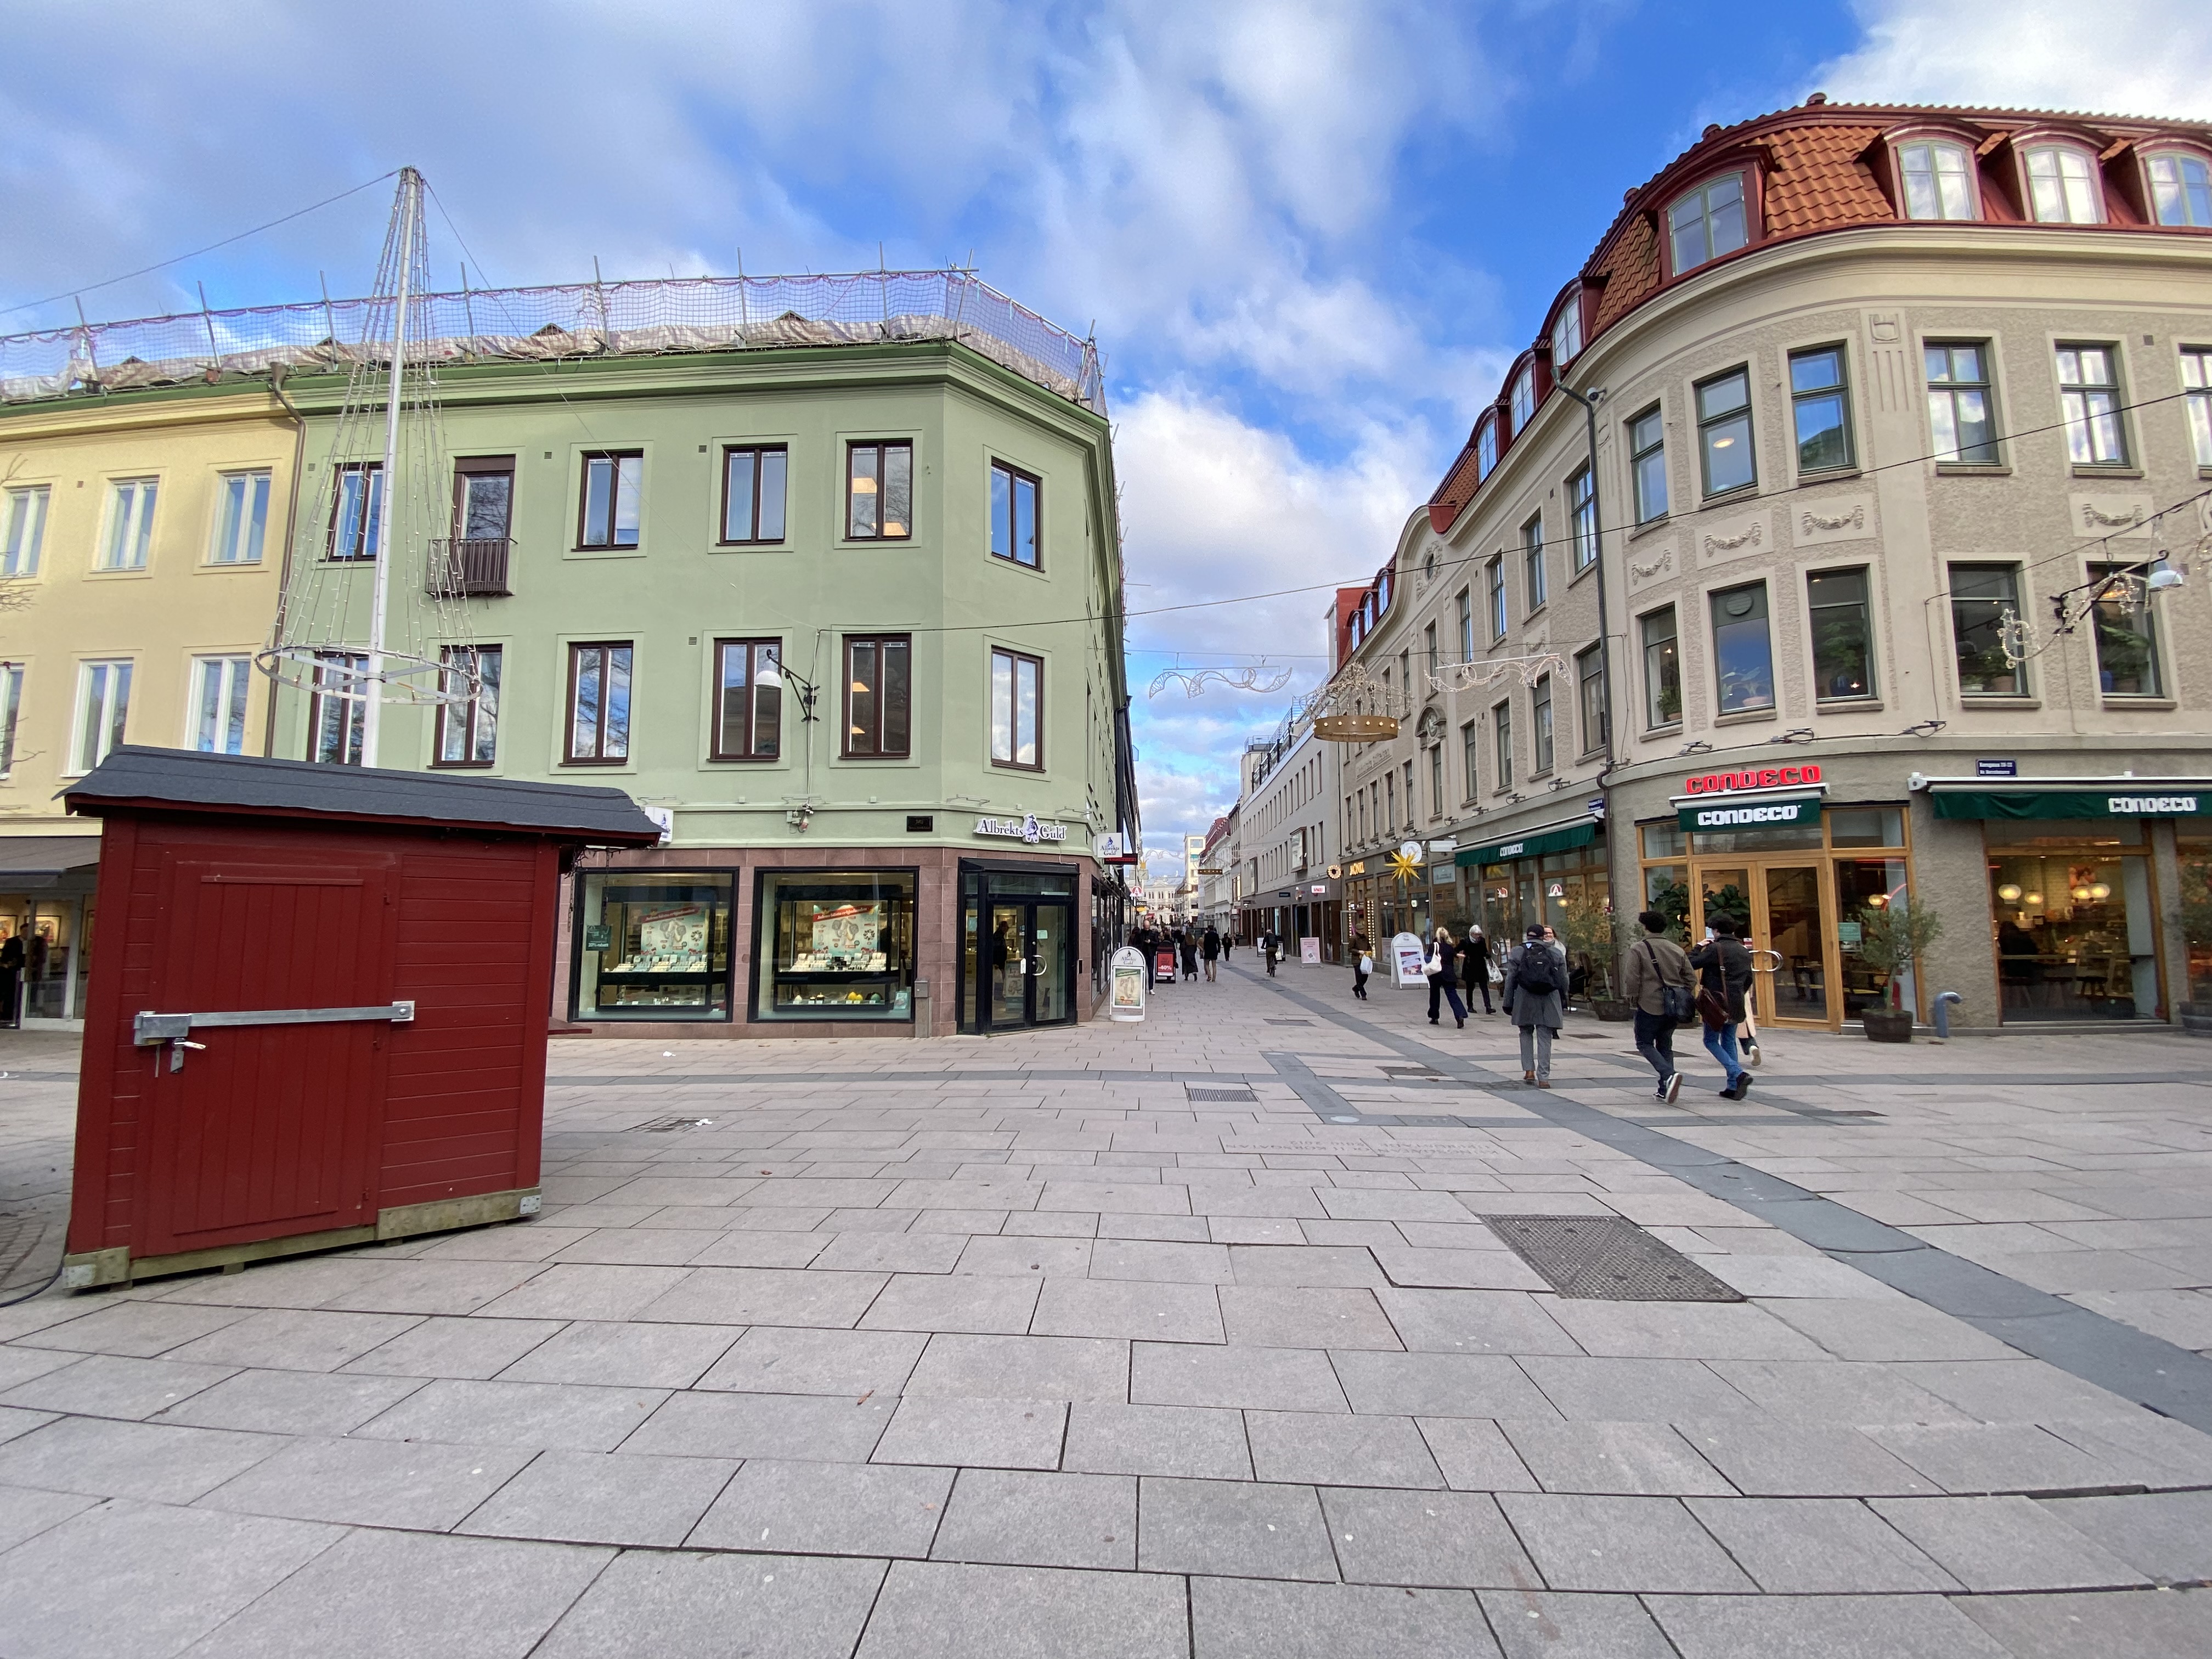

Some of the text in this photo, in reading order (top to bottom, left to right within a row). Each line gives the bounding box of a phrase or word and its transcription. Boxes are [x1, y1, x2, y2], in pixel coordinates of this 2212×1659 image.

[1685, 765, 1821, 794] CONDECO
[2108, 797, 2197, 812] CONDECO
[979, 819, 1065, 839] Albrekts Guld
